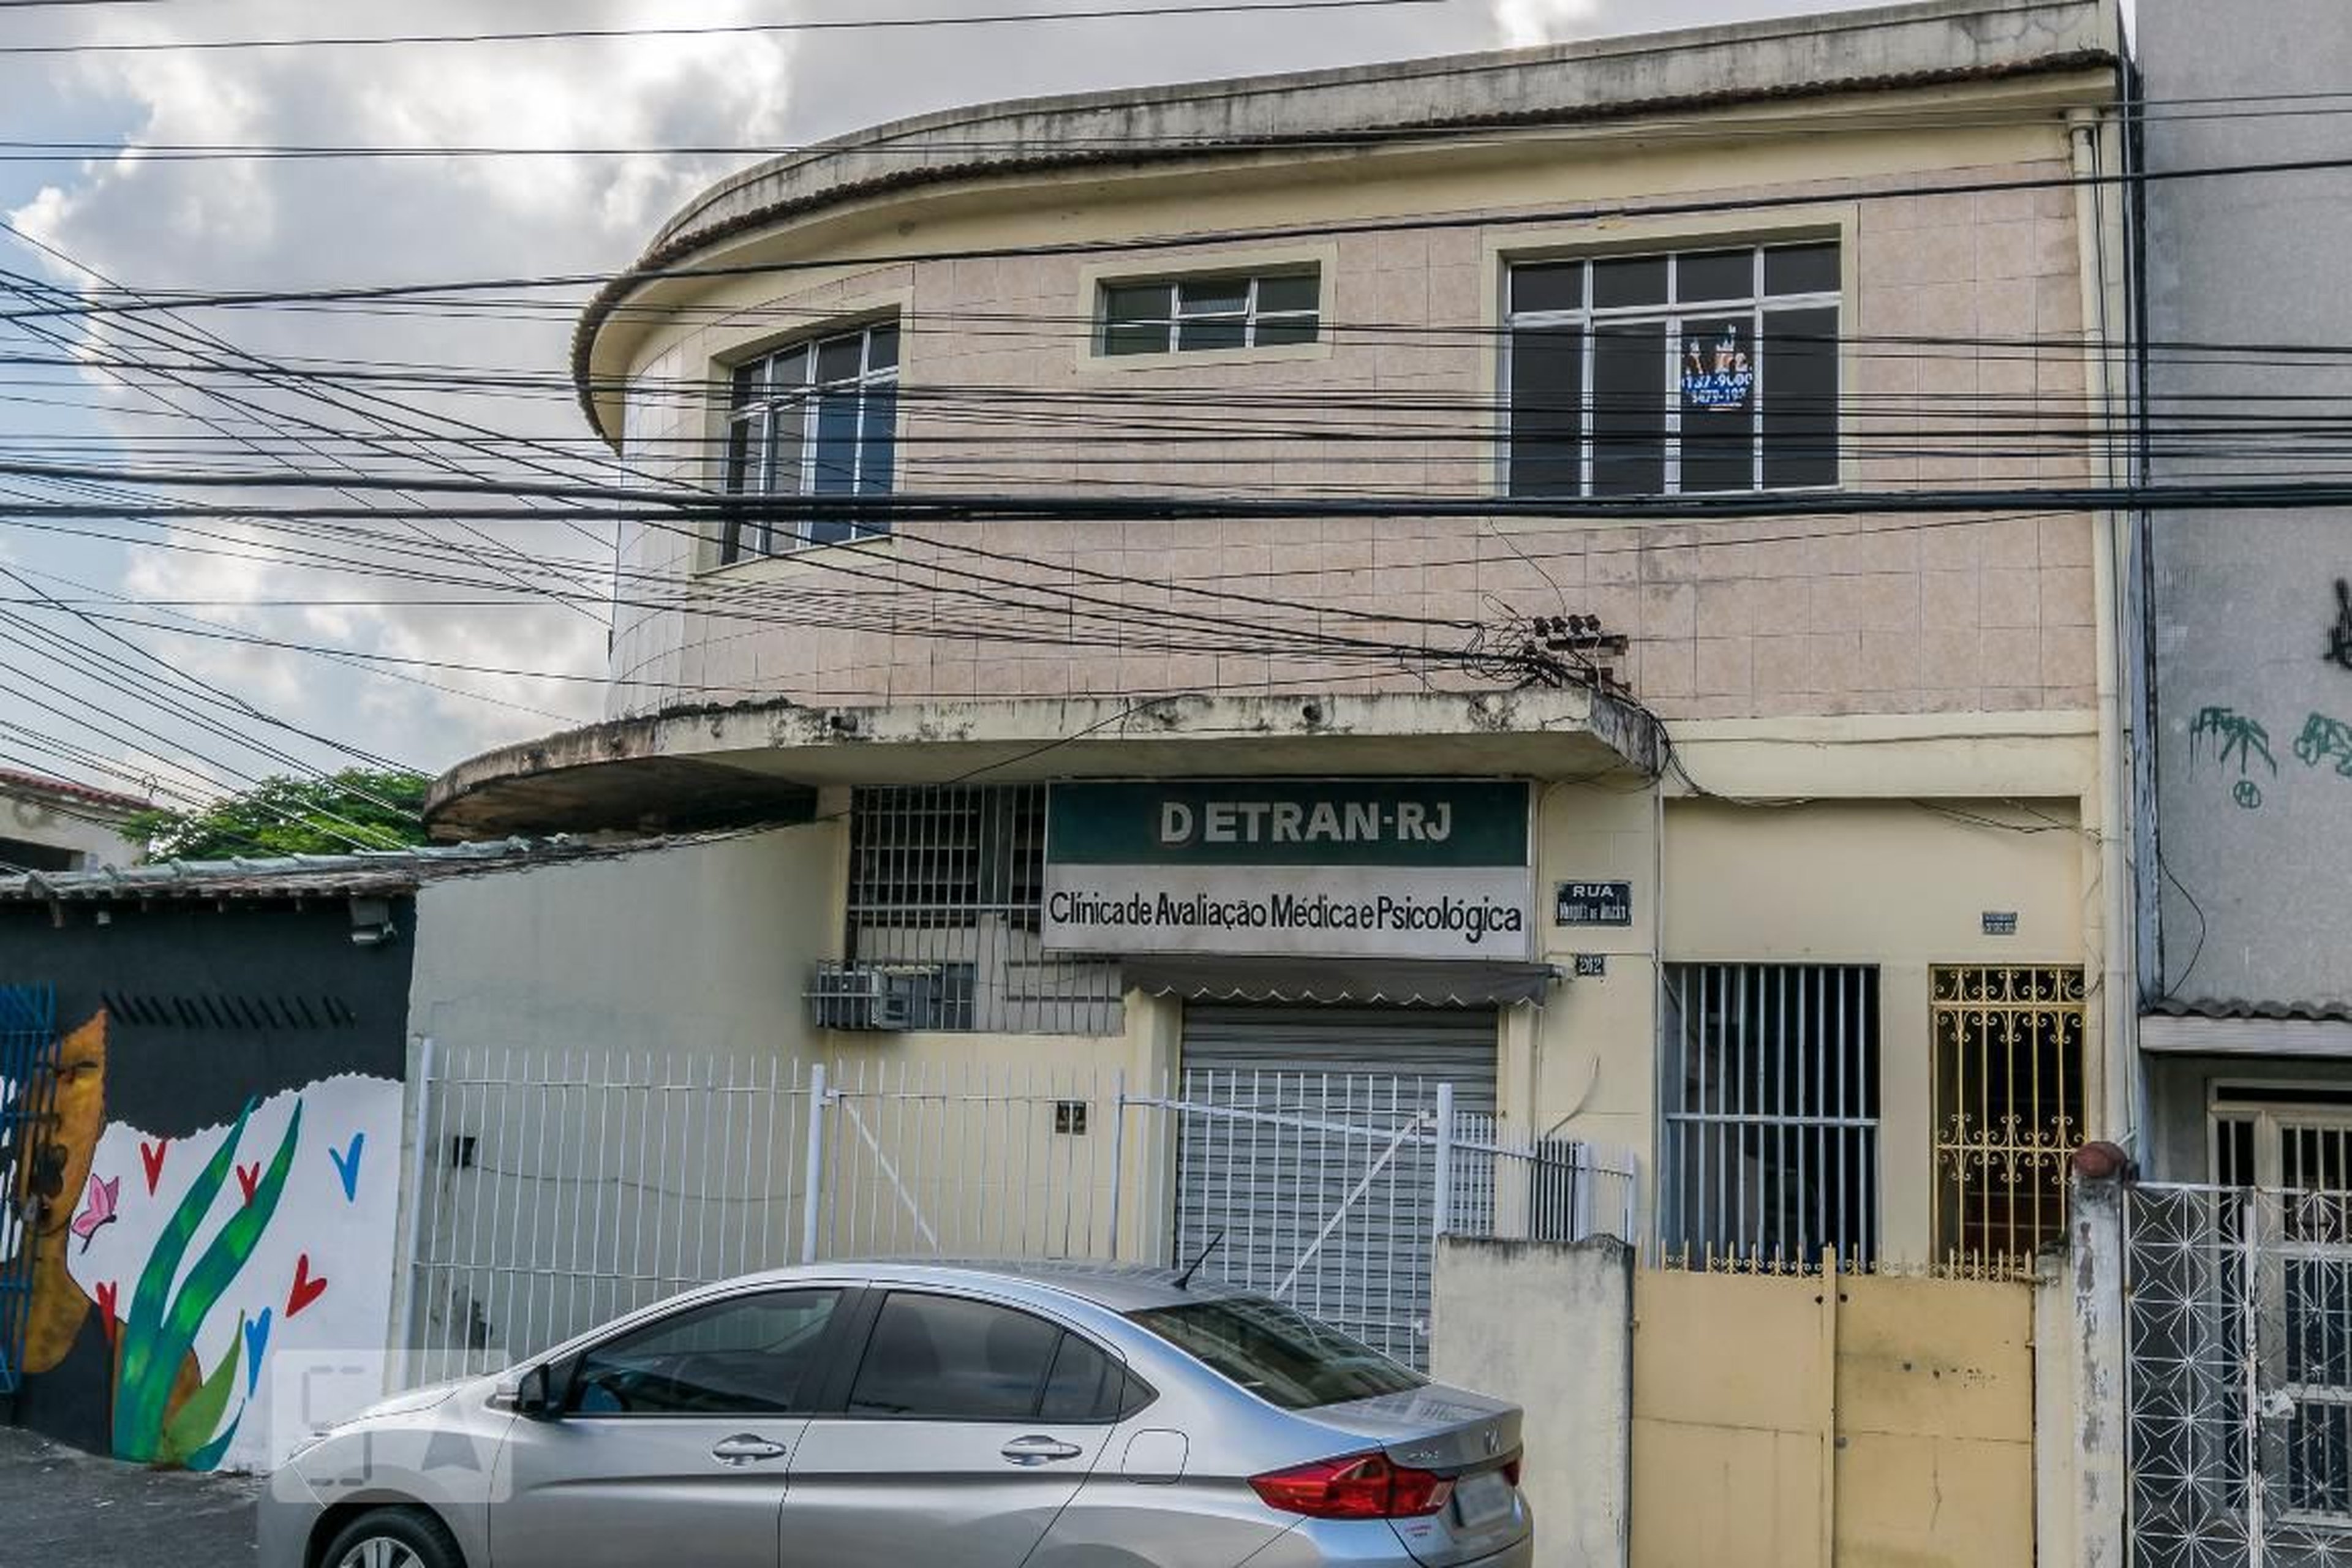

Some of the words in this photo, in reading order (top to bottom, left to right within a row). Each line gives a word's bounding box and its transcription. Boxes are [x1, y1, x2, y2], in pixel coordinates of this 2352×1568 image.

[1572, 885, 1614, 897] RUA
[1050, 892, 1125, 925] Clínica
[1127, 892, 1152, 926] de
[1155, 892, 1267, 930] Avaliação
[1271, 894, 1358, 929] Médica
[1360, 903, 1374, 929] e
[1377, 895, 1521, 944] Psicológica
